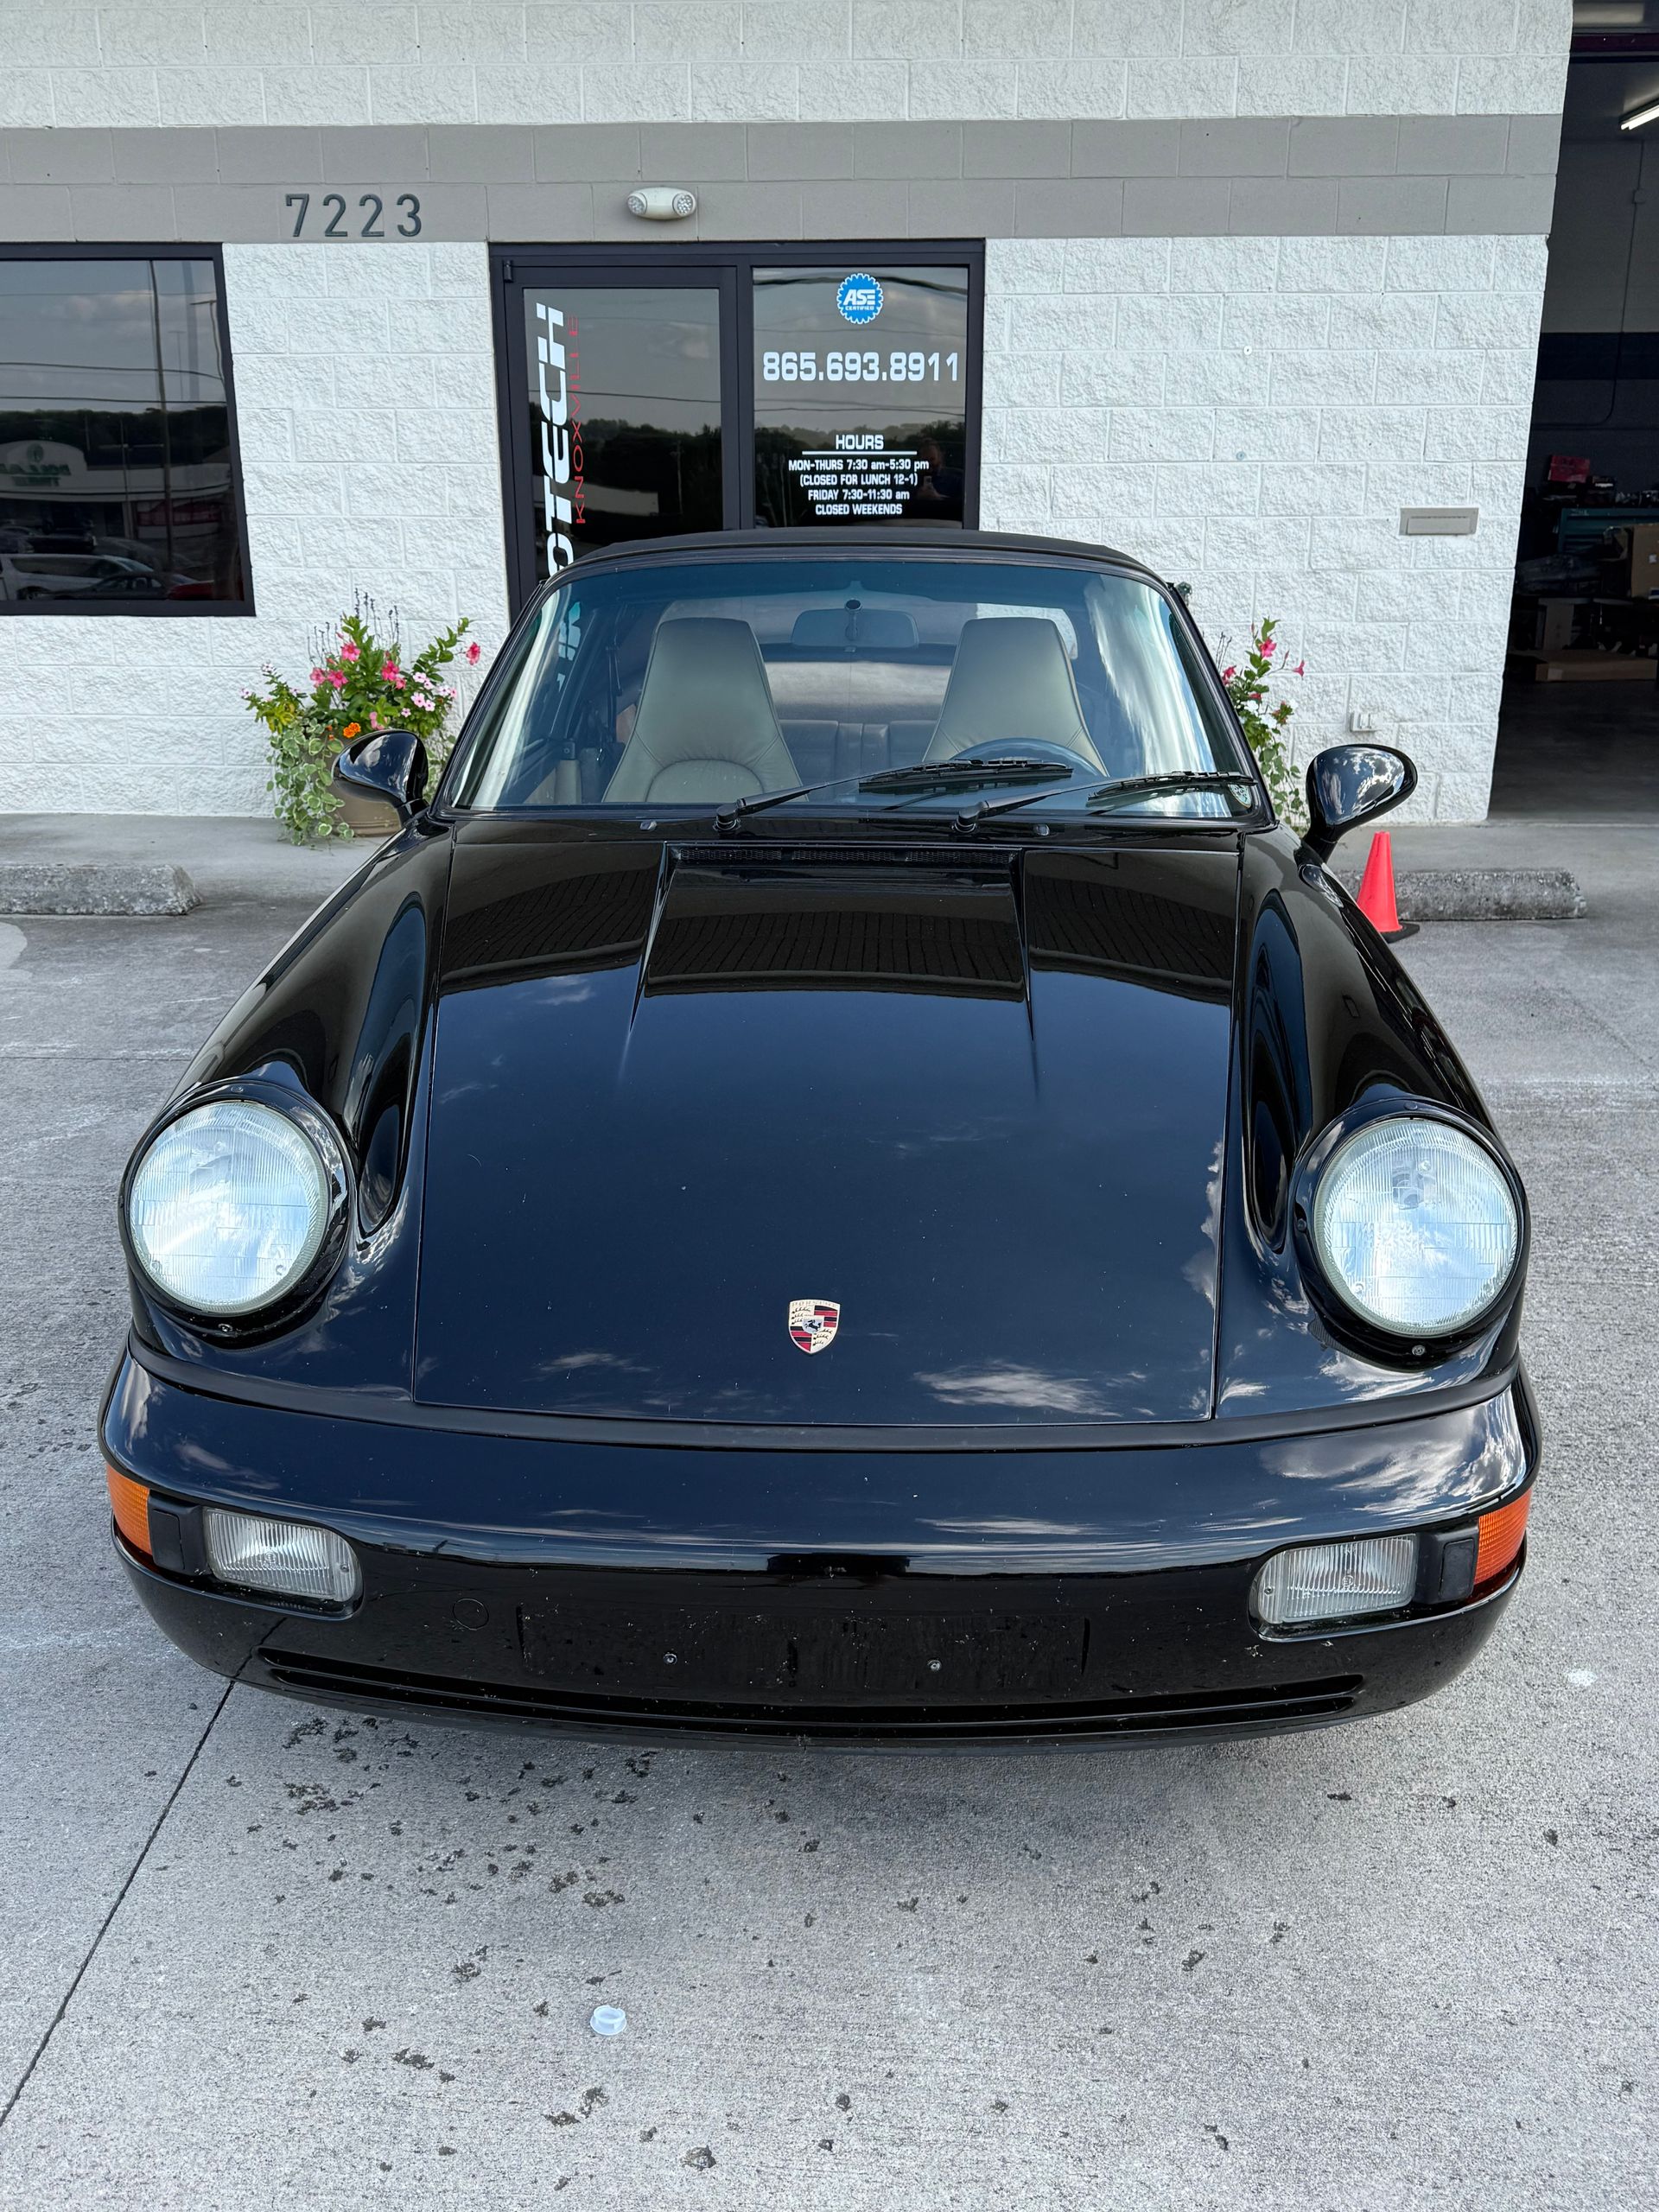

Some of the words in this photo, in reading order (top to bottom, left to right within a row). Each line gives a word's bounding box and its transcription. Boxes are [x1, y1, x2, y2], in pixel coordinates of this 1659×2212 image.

[285, 193, 422, 238] 7223
[842, 289, 876, 306] ASE
[762, 352, 958, 382] 865.693.8911
[567, 315, 586, 524] KNOXVILLE
[835, 434, 885, 450] HOURS
[788, 459, 844, 471] MON-THURS
[846, 458, 868, 470] 7:30
[870, 458, 912, 470] am-5:30
[913, 460, 930, 473] pm
[799, 474, 838, 487] (CLOSED
[840, 474, 858, 486] FOR
[861, 473, 891, 486] LUNCH
[893, 473, 918, 486] 12-1)
[807, 489, 839, 501] FRIDAY
[842, 488, 893, 500] 7:30-11:30
[895, 490, 911, 500] am
[815, 503, 850, 516] CLOSED
[852, 503, 903, 515] WEEKENDS
